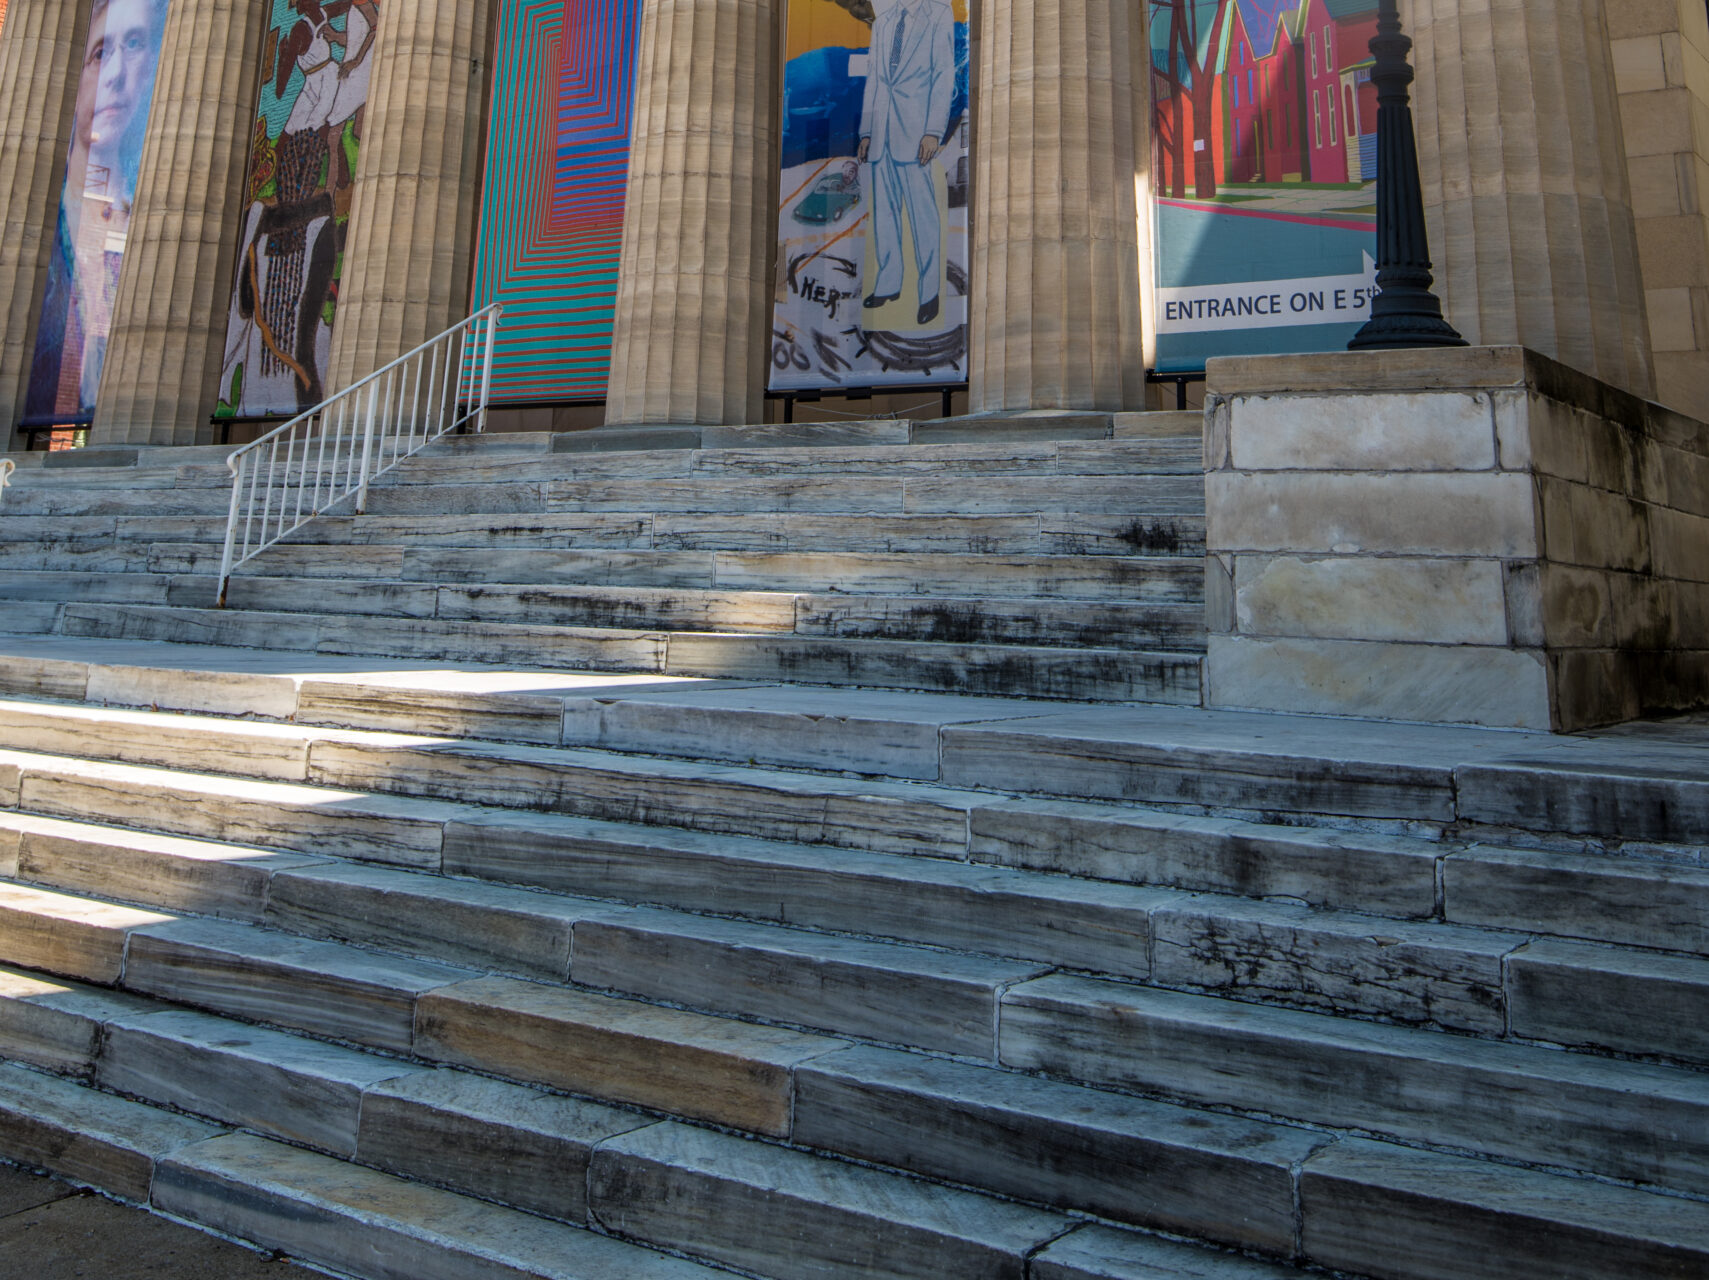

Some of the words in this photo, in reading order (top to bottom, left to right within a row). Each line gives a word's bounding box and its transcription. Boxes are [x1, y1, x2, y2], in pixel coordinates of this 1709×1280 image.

[1165, 294, 1282, 321] ENTRANCE
[1289, 291, 1325, 312] ON
[1334, 289, 1346, 310] E
